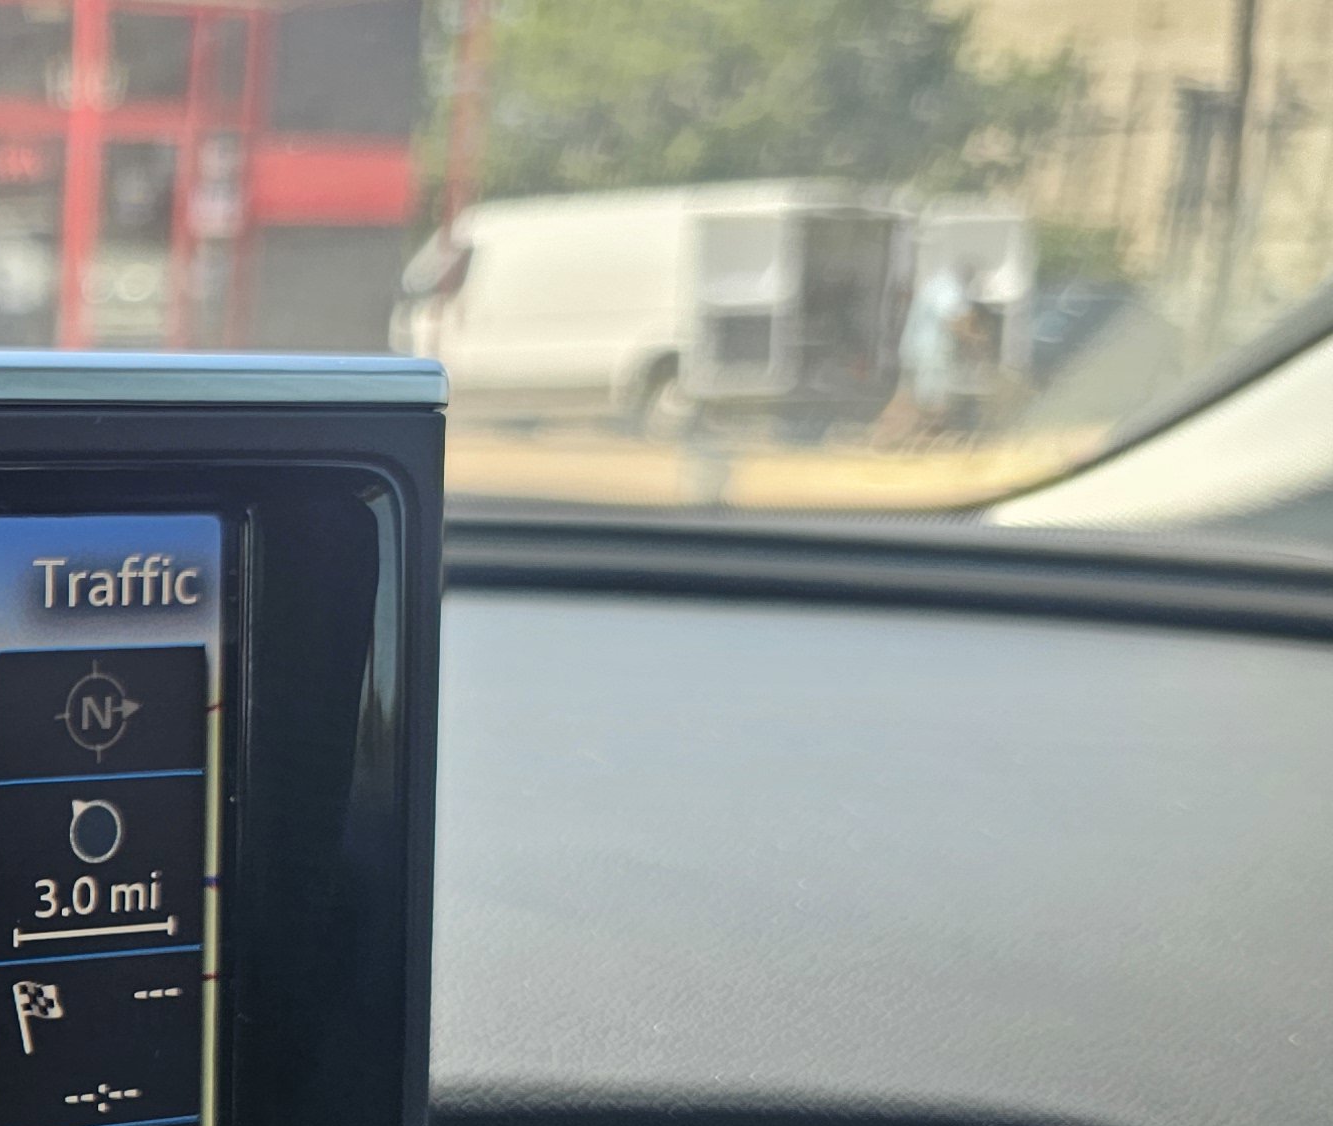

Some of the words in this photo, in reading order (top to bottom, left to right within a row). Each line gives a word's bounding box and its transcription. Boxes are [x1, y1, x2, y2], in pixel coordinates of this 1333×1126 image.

[33, 553, 199, 608] Traffic
[81, 696, 113, 730] N
[34, 875, 96, 918] 3.0
[111, 871, 162, 912] mi
